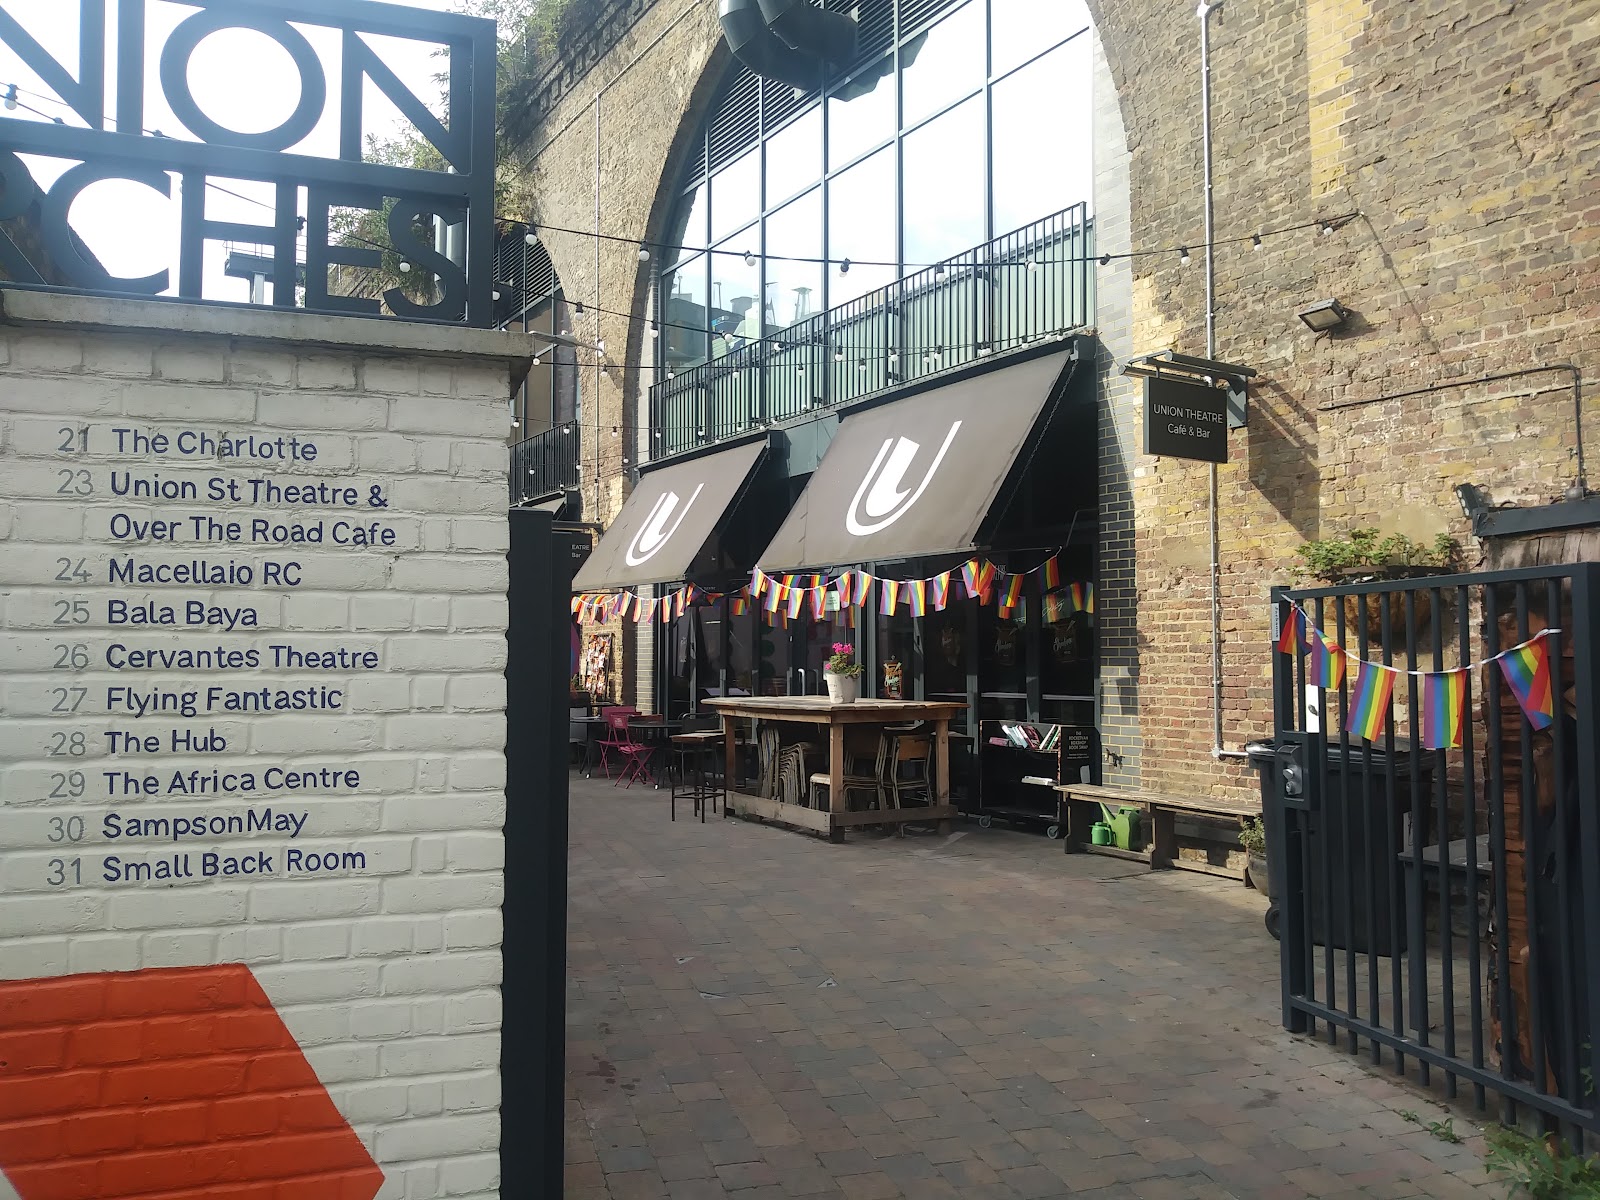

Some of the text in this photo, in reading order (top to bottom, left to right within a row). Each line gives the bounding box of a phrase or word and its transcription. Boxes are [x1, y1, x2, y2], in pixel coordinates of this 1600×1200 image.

[1153, 404, 1223, 424] UNION THEATRE
[57, 427, 319, 462] 21 The Charlotte
[1167, 423, 1211, 438] Café & Bar
[57, 469, 388, 508] 23 Union St Theatre &
[110, 513, 396, 545] Over The Road Cafe
[55, 558, 301, 586] 24 Macellaio RC
[54, 599, 257, 630] 25 Bala Baya
[53, 644, 379, 669] 26 Cervantes Theatre
[52, 687, 341, 717] 27 Flying Fantastic
[51, 729, 227, 756] 28 The Hub
[50, 767, 360, 798] 29 The Africa Centre
[48, 808, 307, 843] 30 SampsonMay
[47, 848, 366, 885] 31 Small Back Room
